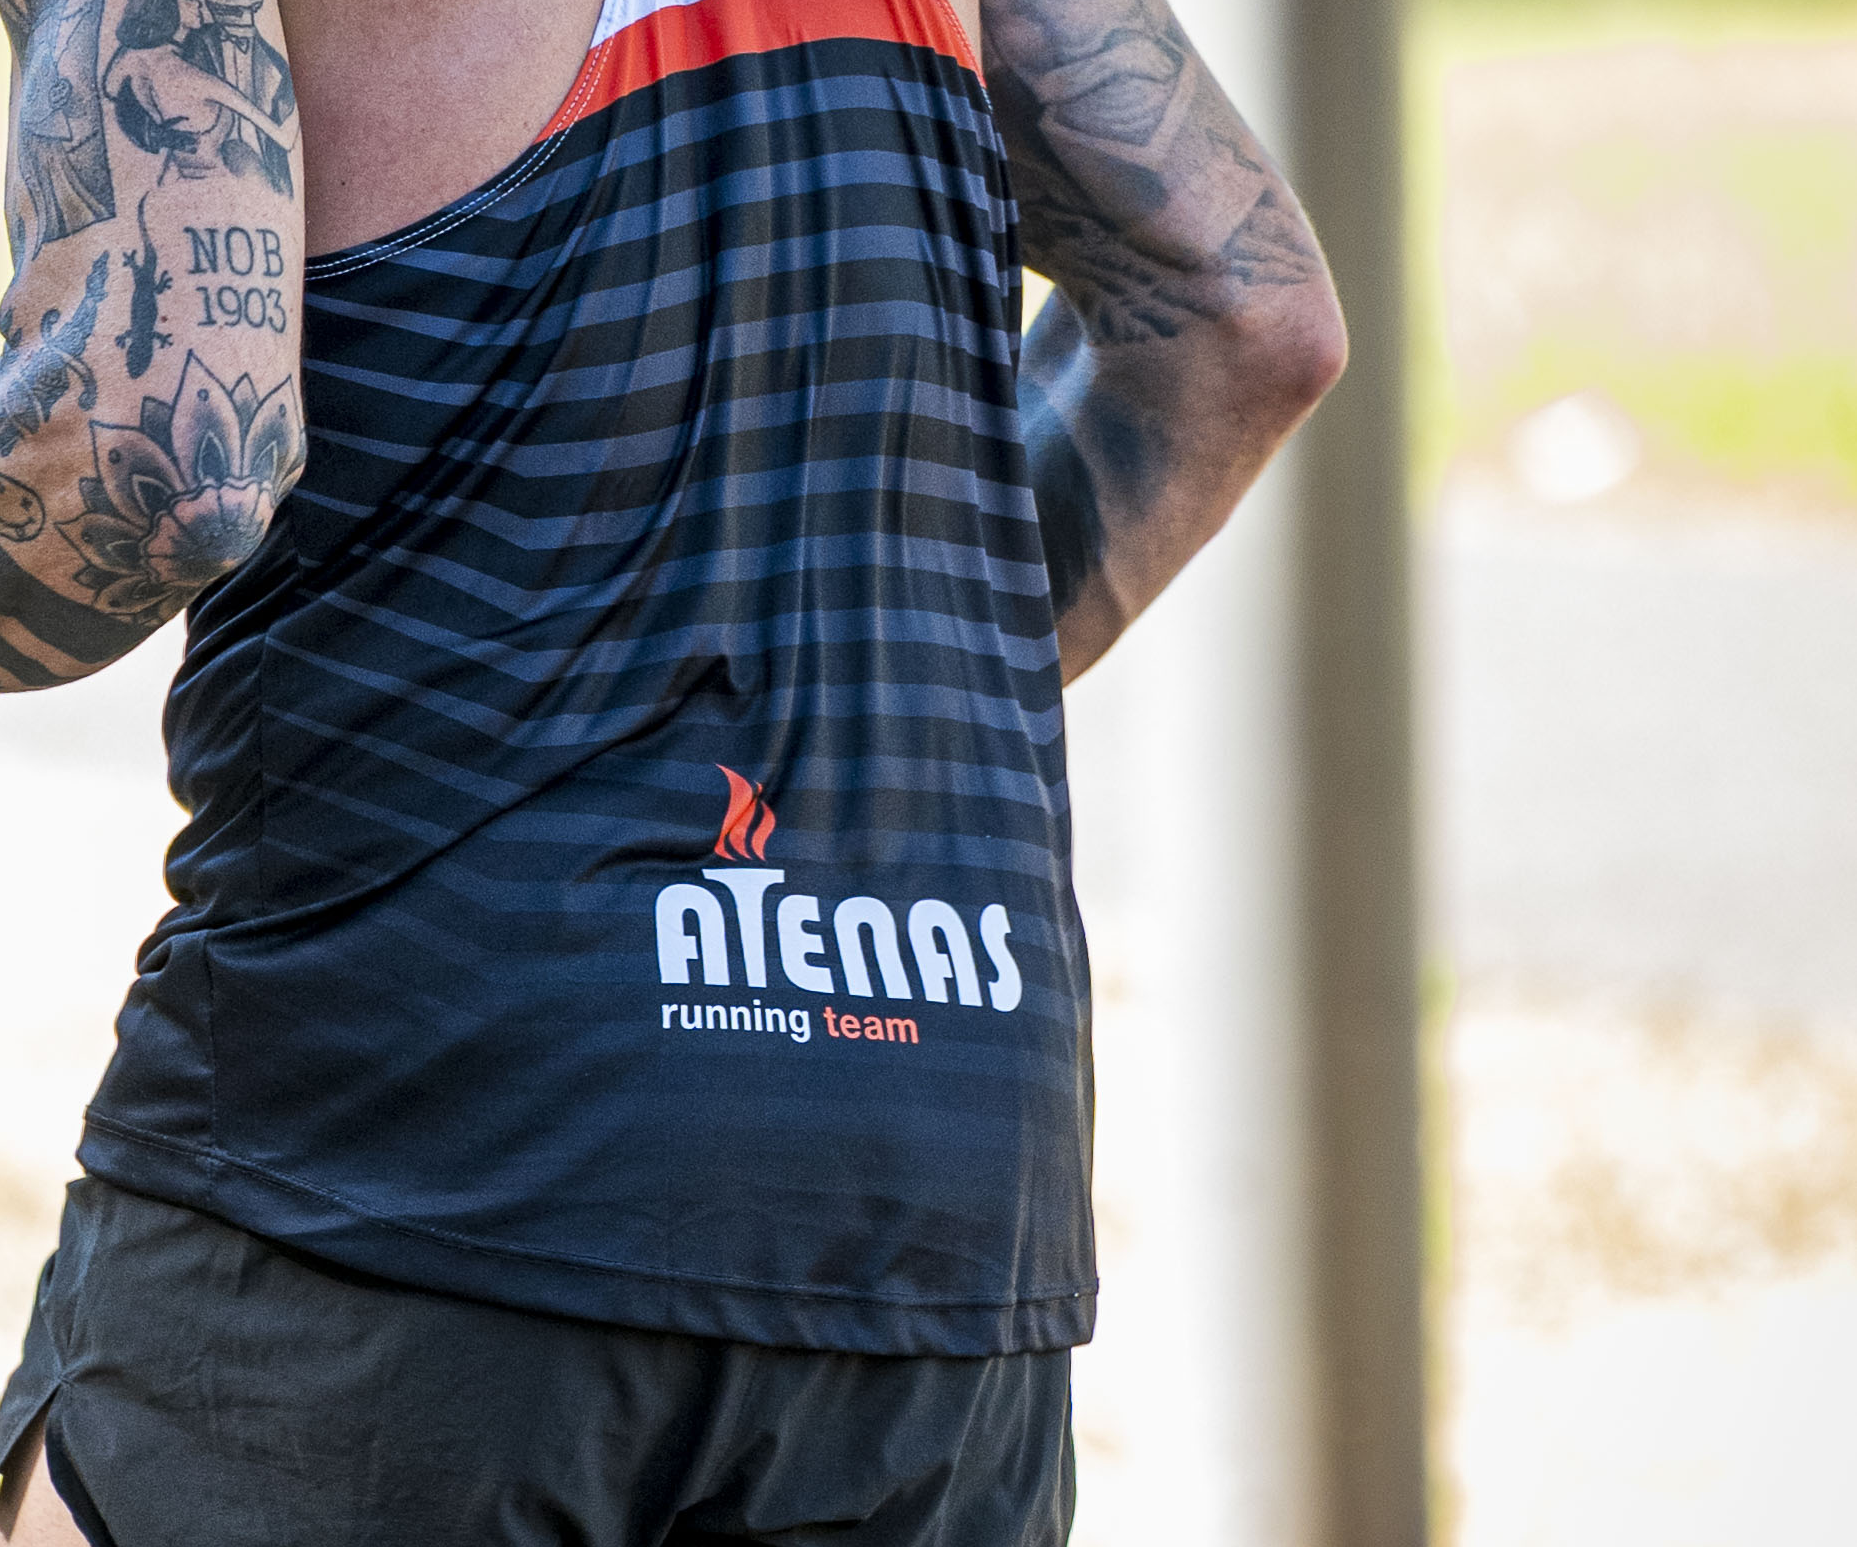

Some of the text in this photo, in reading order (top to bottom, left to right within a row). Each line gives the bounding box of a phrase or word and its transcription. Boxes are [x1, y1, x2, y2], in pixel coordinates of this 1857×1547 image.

[184, 226, 285, 278] NOB
[196, 285, 287, 334] 1903
[655, 868, 1023, 1012] ATENAS
[661, 999, 919, 1044] running team
